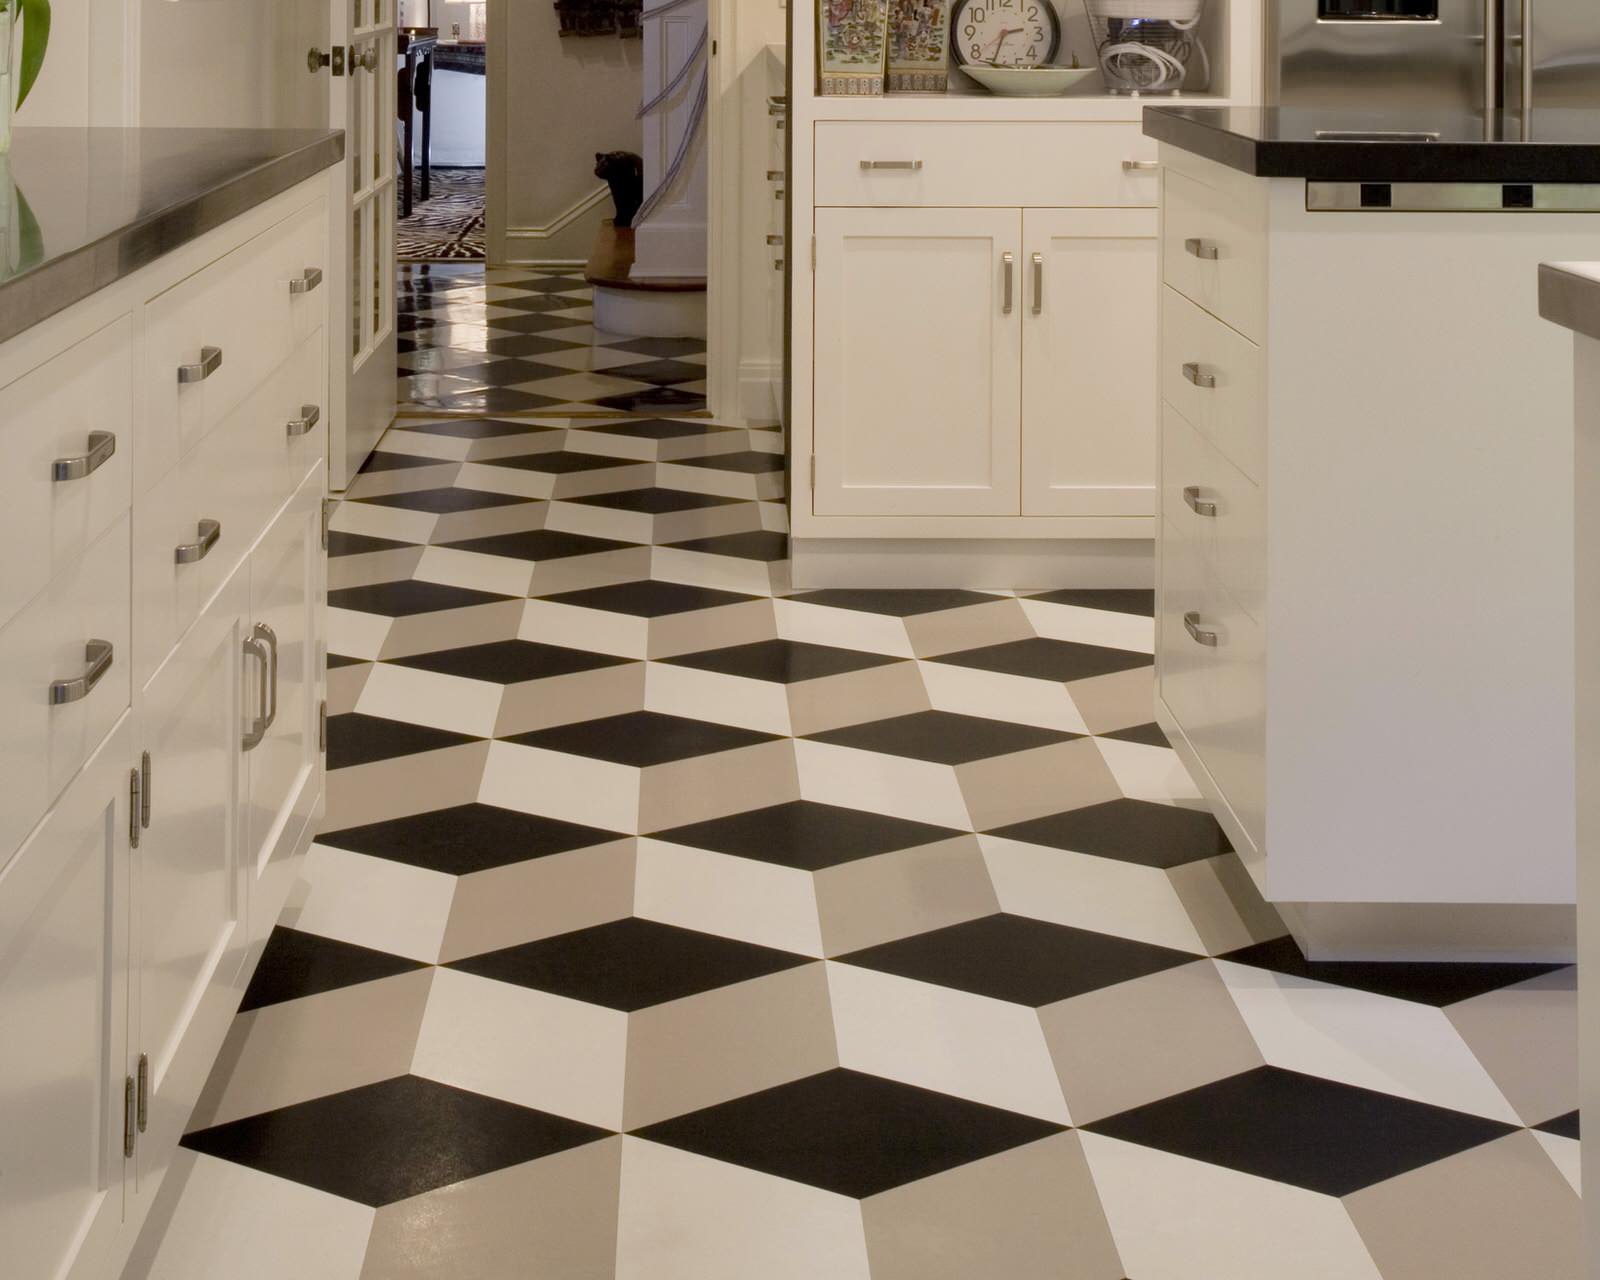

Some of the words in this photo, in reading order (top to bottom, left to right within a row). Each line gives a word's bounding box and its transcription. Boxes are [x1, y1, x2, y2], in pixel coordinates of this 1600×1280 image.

[968, 7, 985, 24] 10
[1027, 6, 1038, 22] 2
[964, 24, 976, 41] 9
[1033, 27, 1044, 42] 3
[970, 44, 981, 60] 8
[1026, 44, 1038, 60] 4
